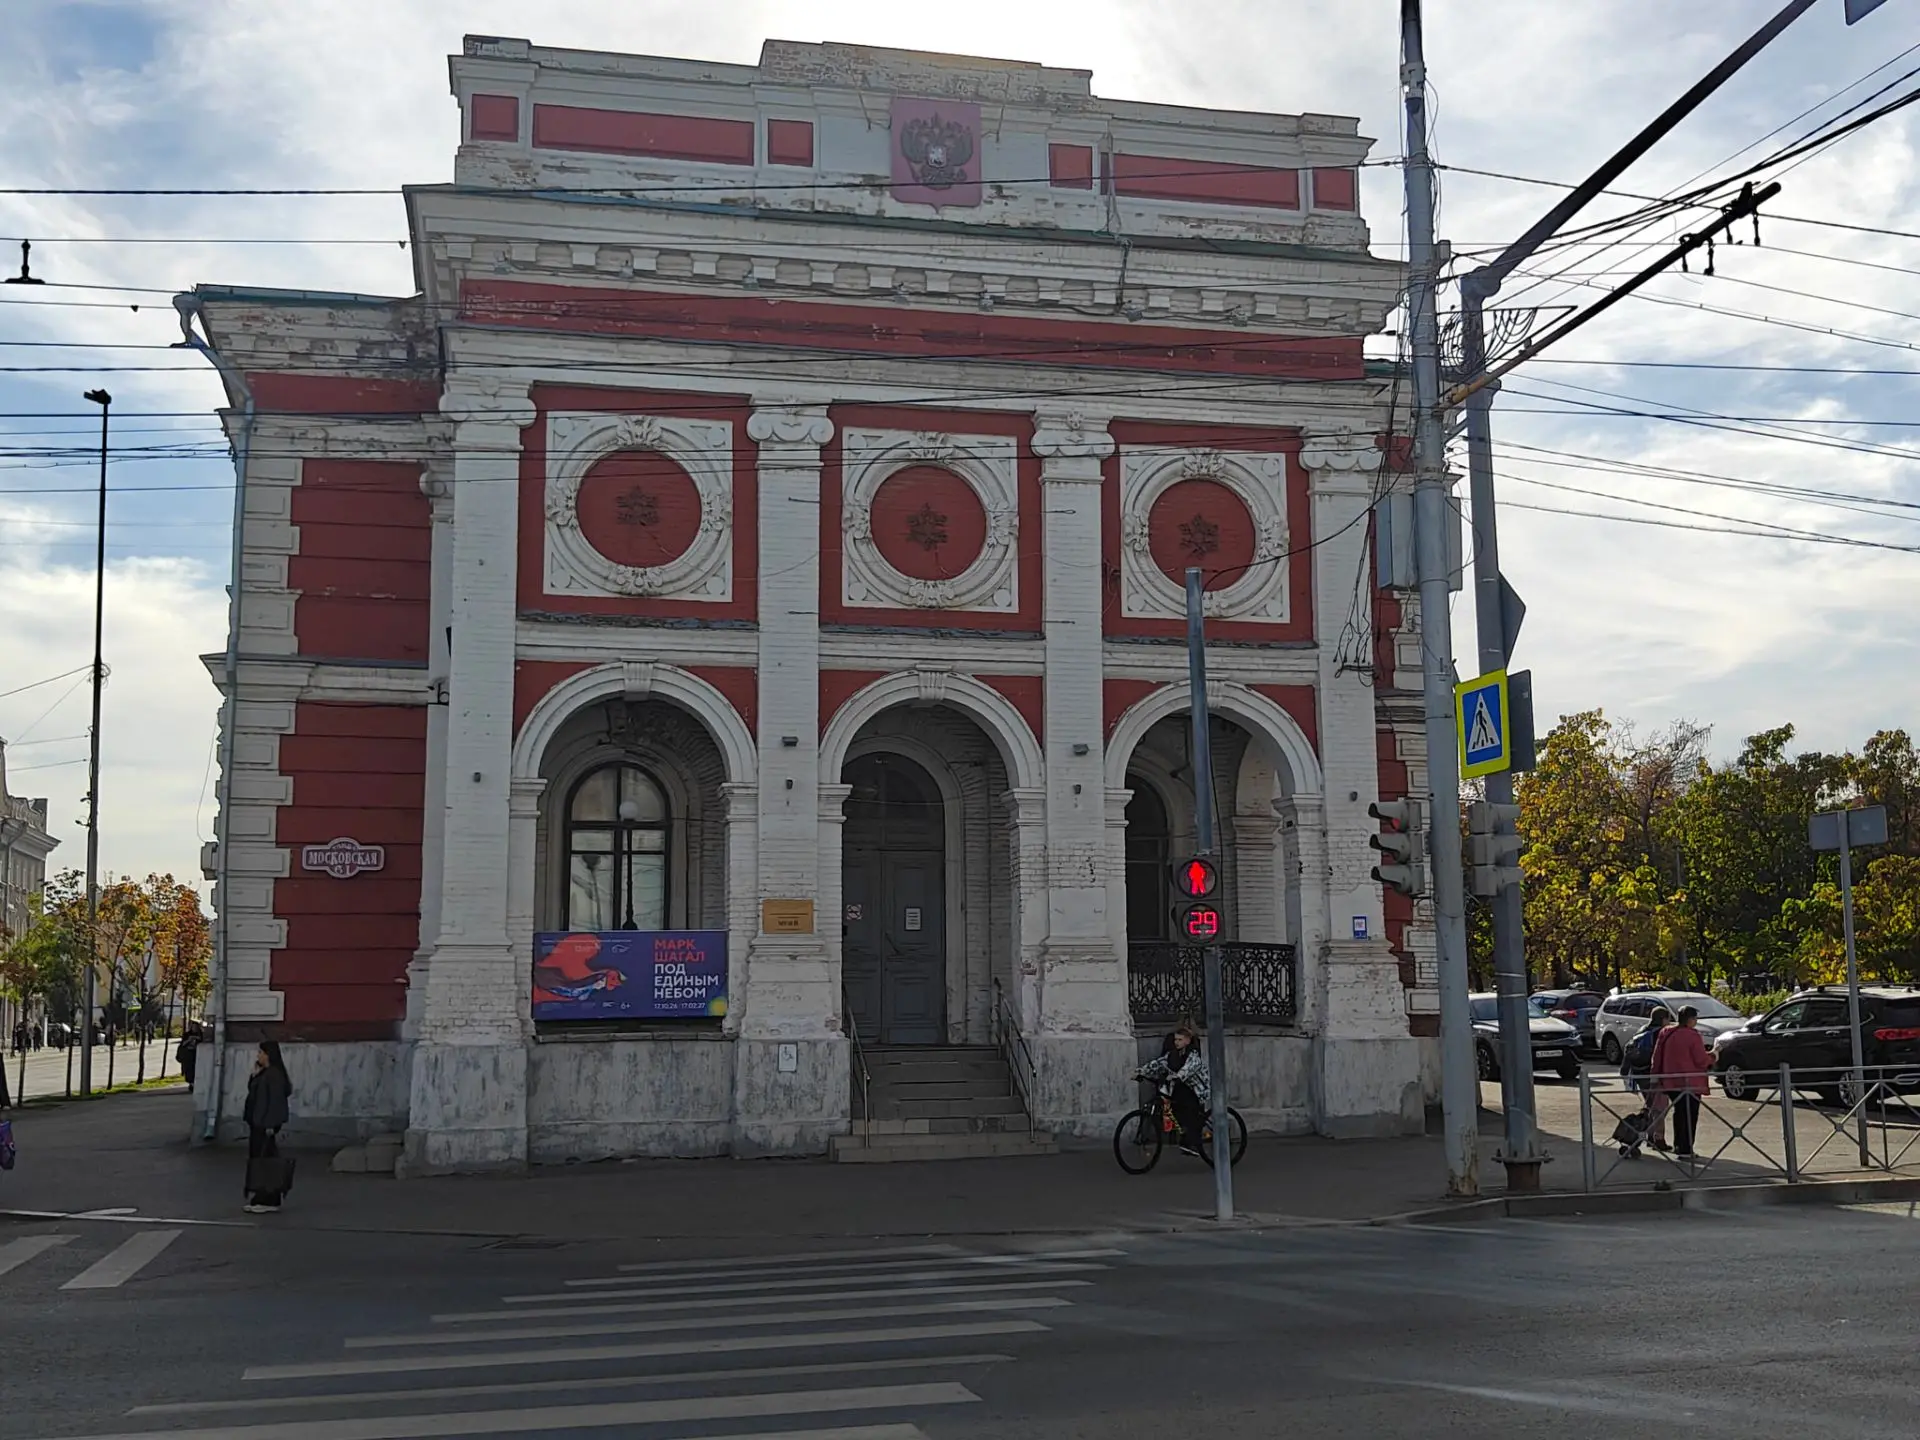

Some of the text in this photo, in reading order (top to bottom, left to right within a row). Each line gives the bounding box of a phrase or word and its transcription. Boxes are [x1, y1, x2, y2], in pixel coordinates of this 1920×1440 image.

[308, 851, 378, 865] МОСКОВСКАЯ
[1189, 911, 1217, 934] 29
[654, 939, 697, 950] МАРК
[654, 951, 705, 962] ШАГАЛ
[654, 963, 686, 975] ПОД
[654, 975, 719, 988] ЕДИНЫМ
[654, 987, 706, 998] НЕБОМ
